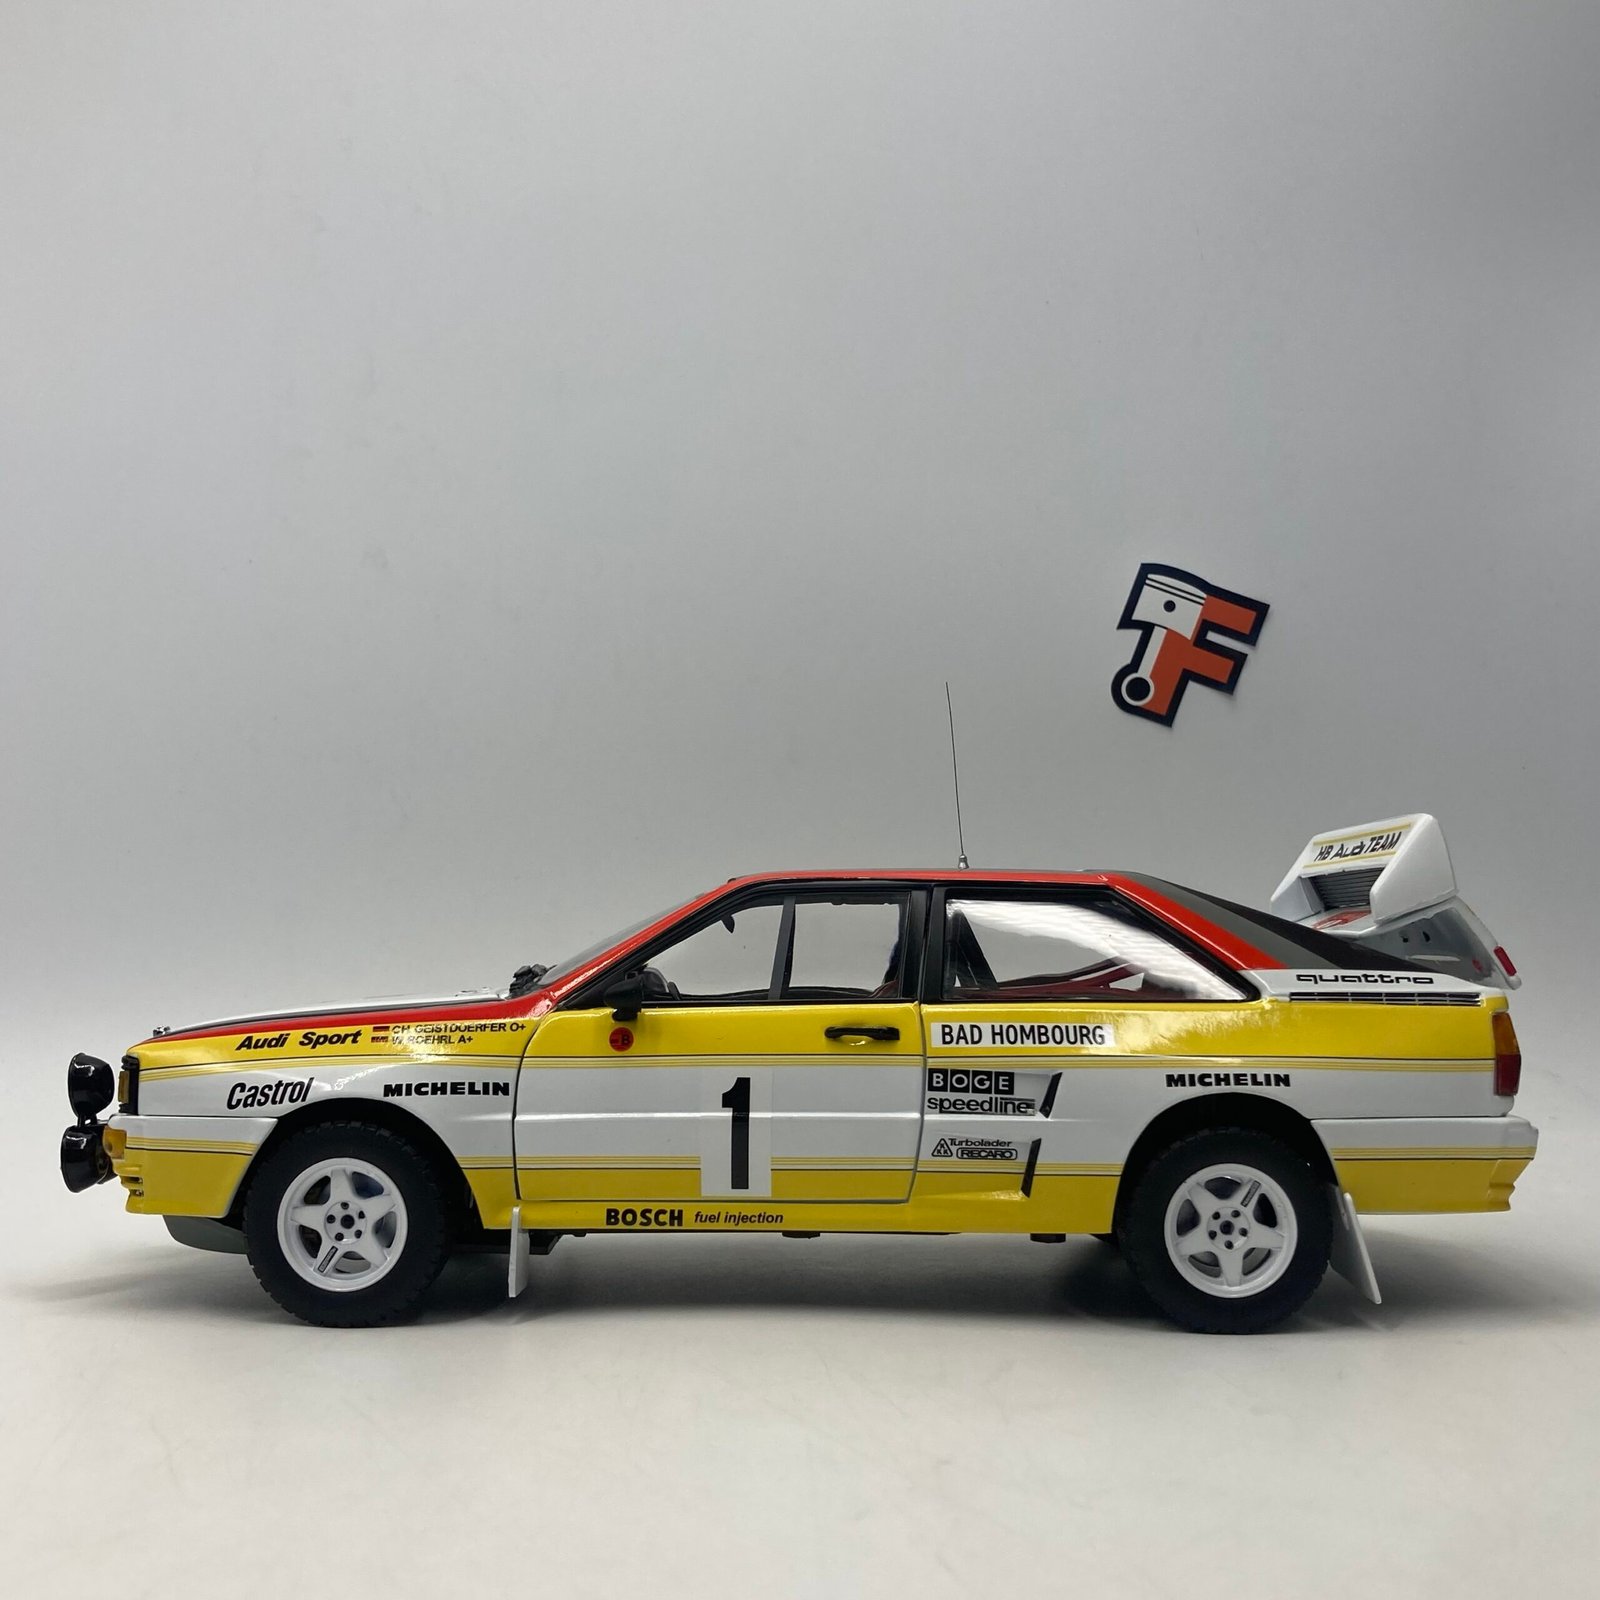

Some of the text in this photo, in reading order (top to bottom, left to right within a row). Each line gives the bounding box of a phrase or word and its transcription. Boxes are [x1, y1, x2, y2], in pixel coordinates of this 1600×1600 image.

[1314, 845, 1334, 861] HB
[1363, 832, 1402, 854] TEAM
[1296, 973, 1434, 985] quattro
[235, 1029, 363, 1051] Audi Sport
[941, 1024, 1106, 1046] BAD HOMBOURG
[383, 1081, 510, 1097] MICHELIN
[931, 1071, 1010, 1092] BOGE
[1165, 1073, 1291, 1087] MICHELIN
[226, 1077, 315, 1110] Castrol
[927, 1096, 1031, 1116] speedline
[722, 1077, 751, 1189] 1
[948, 1138, 1013, 1148] Turbolader
[960, 1149, 1014, 1159] RECARO
[605, 1208, 784, 1227] BOSCH fuel injection
